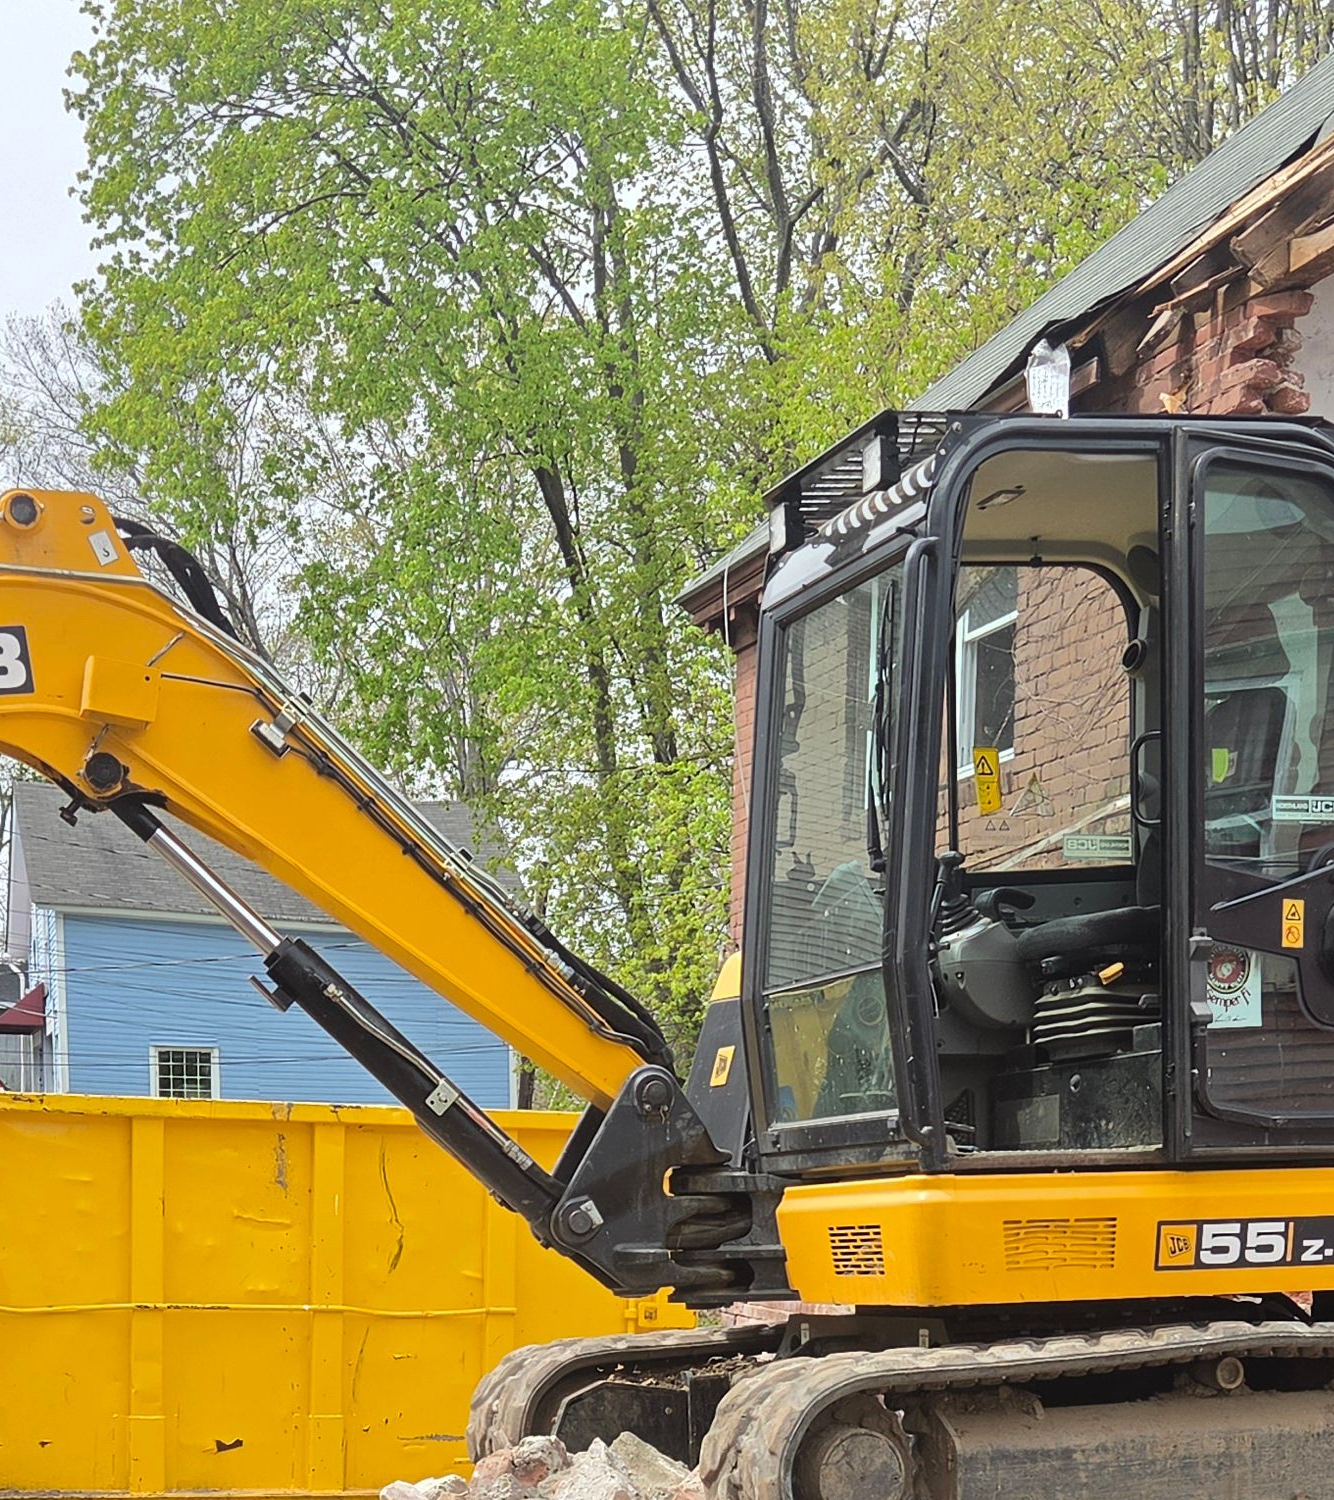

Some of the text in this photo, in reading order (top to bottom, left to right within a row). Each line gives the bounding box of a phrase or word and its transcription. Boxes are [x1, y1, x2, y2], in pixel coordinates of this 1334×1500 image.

[1207, 989, 1241, 1012] Semper
[1169, 1236, 1190, 1255] JCB
[1199, 1221, 1286, 1265] 55
